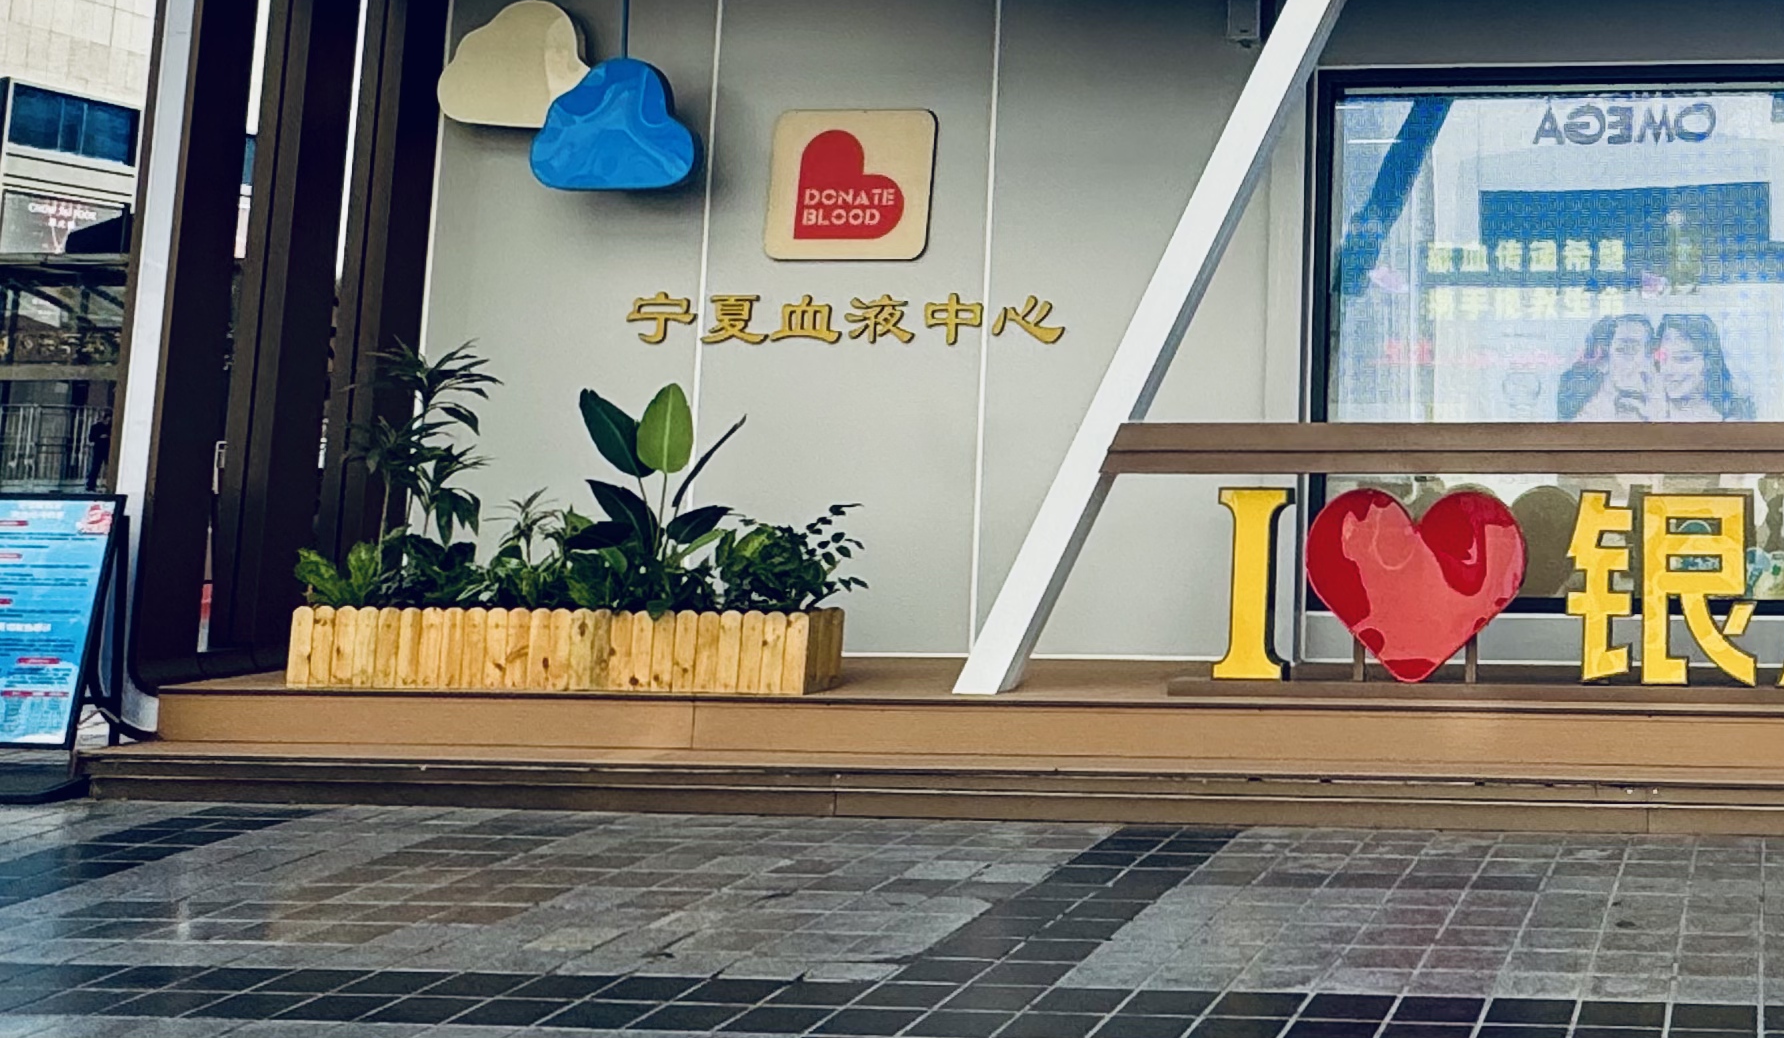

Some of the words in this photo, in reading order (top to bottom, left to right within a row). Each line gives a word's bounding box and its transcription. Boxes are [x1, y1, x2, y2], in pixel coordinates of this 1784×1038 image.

[804, 189, 895, 206] DONATE
[802, 208, 880, 226] BLOOD
[625, 293, 1066, 346] 宁夏血液中心
[1211, 487, 1293, 681] I
